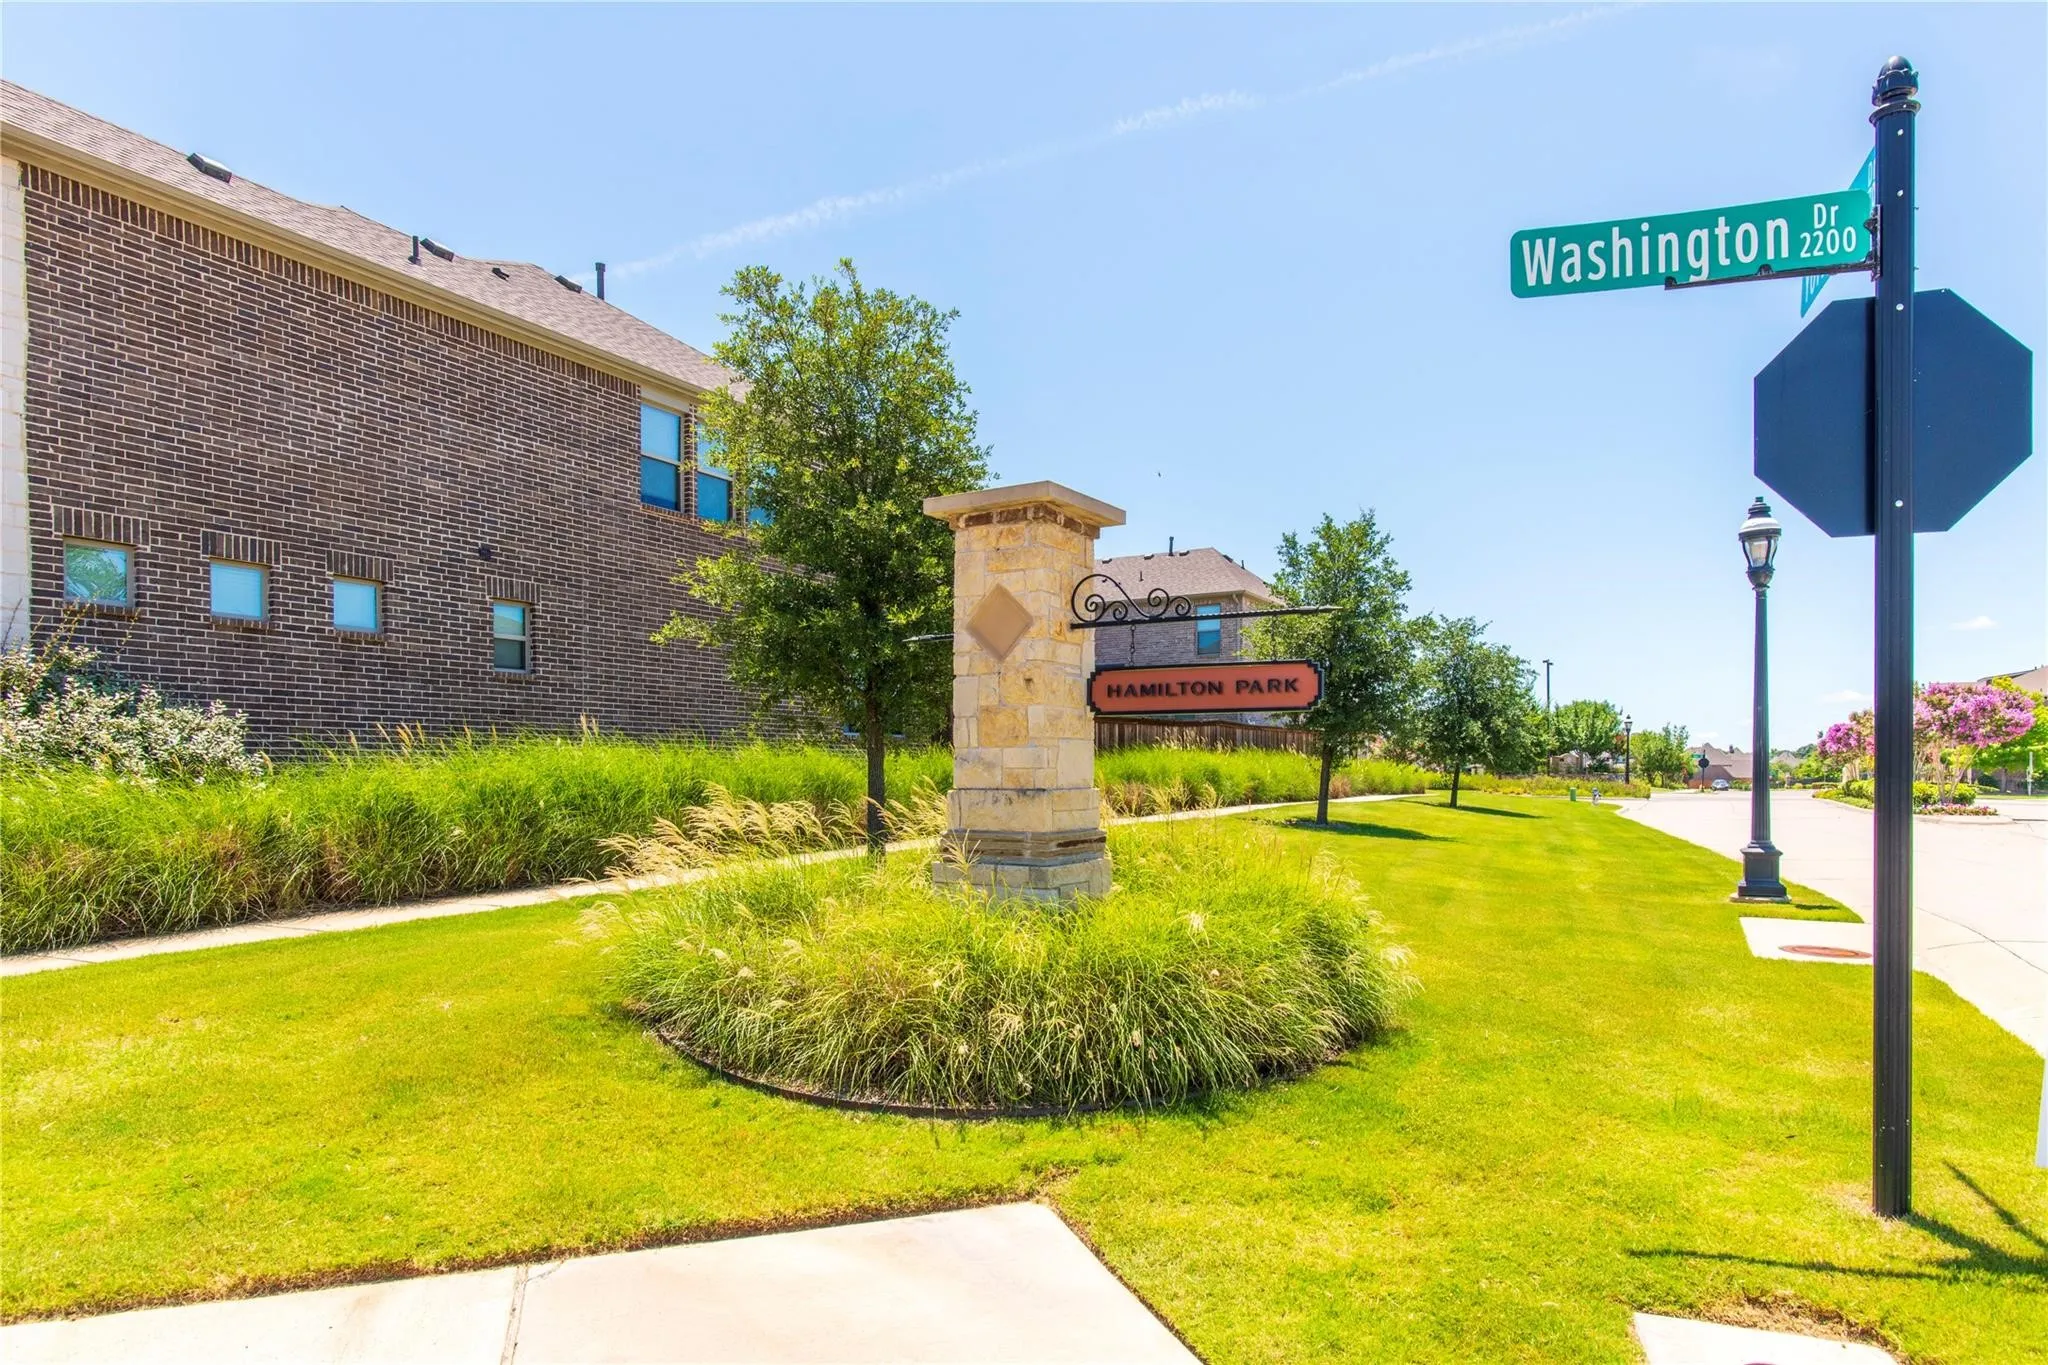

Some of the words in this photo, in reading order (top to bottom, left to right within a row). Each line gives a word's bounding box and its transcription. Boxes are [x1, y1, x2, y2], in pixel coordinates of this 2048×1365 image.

[1522, 216, 1789, 286] Washington
[1814, 203, 1839, 228] Dr
[1800, 226, 1857, 258] 2200
[1107, 680, 1223, 698] HAMILTON
[1235, 678, 1299, 694] PARK
